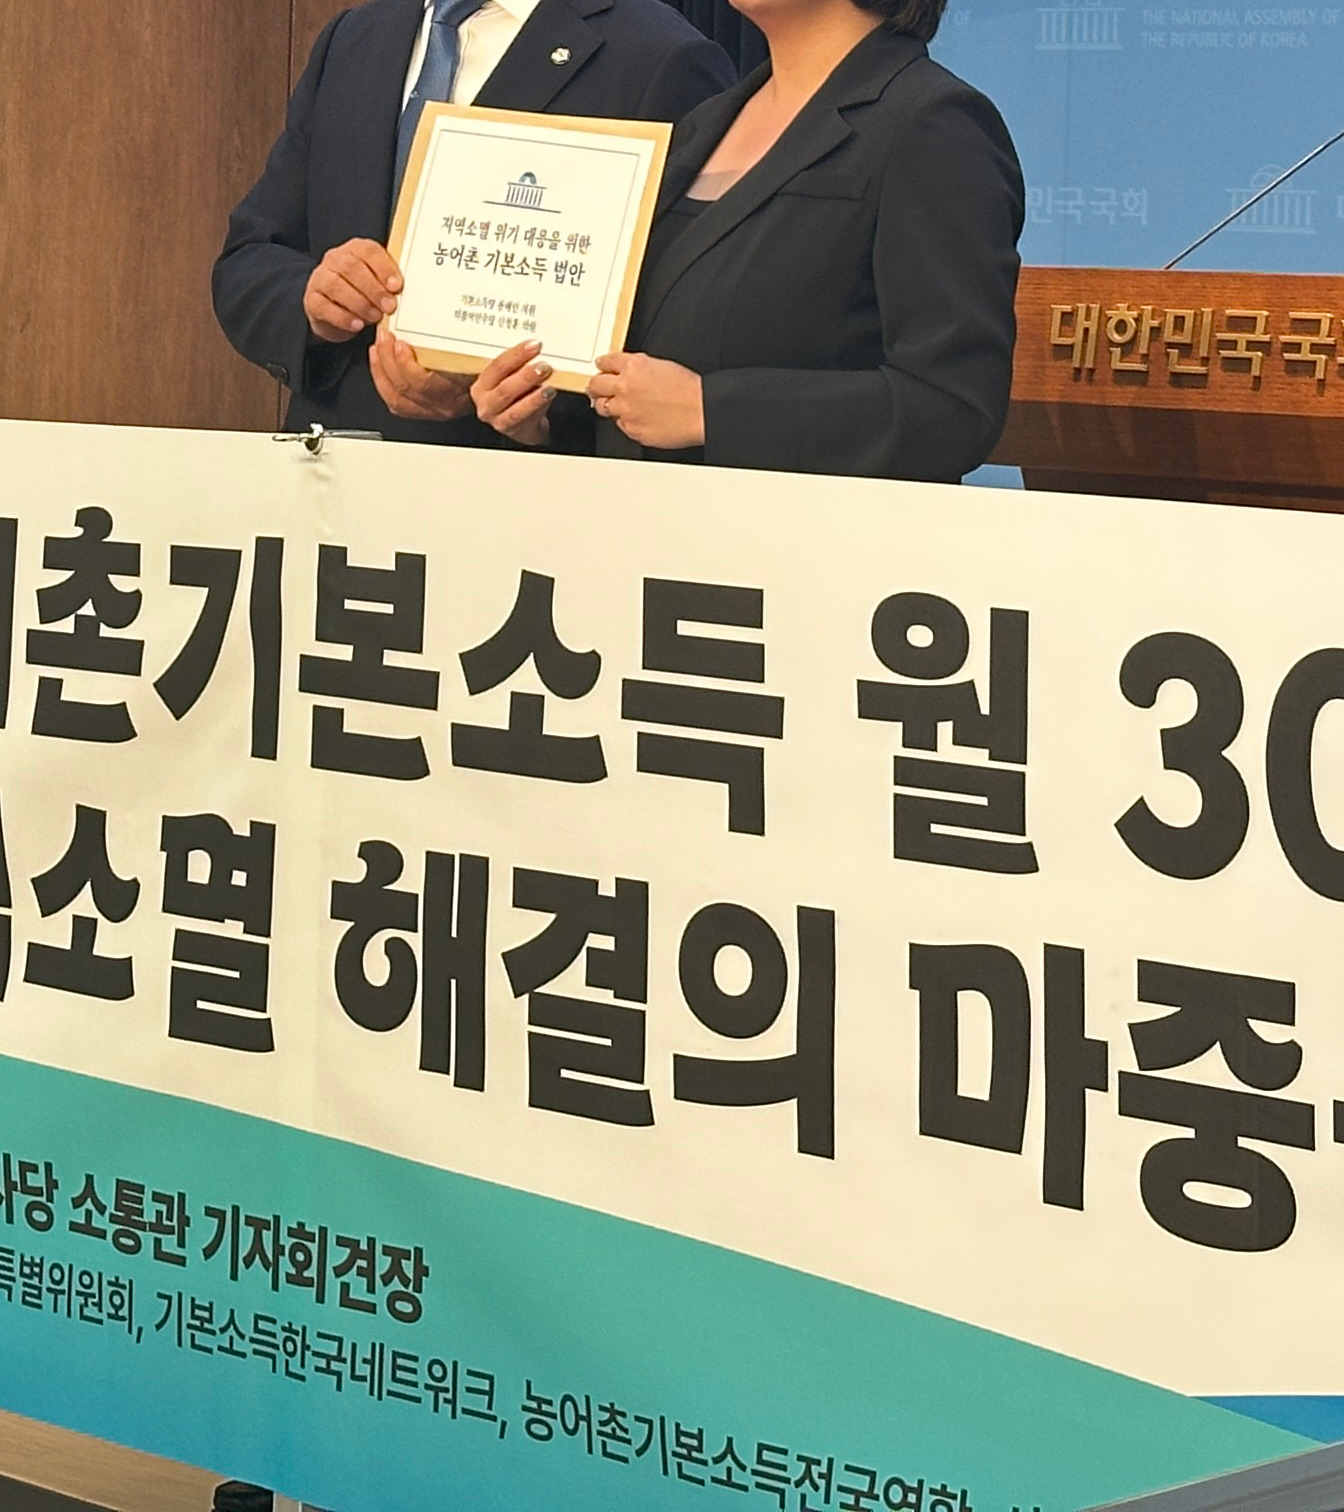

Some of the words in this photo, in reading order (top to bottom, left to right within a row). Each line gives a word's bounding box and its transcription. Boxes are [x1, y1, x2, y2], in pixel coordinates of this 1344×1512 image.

[433, 242, 480, 271] 농어촌
[483, 249, 549, 282] 기본소득
[554, 261, 586, 288] 법안
[494, 222, 520, 244] 위기
[523, 227, 562, 250] 대응을
[564, 233, 592, 255] 위한
[1028, 186, 1148, 226] 민국국회
[856, 591, 1040, 875] 월
[329, 838, 837, 1161] 해결의
[68, 1171, 190, 1266] 소통관
[201, 1202, 430, 1323] 기자회견장
[153, 1289, 509, 1440] 기본소득한국네트워크,
